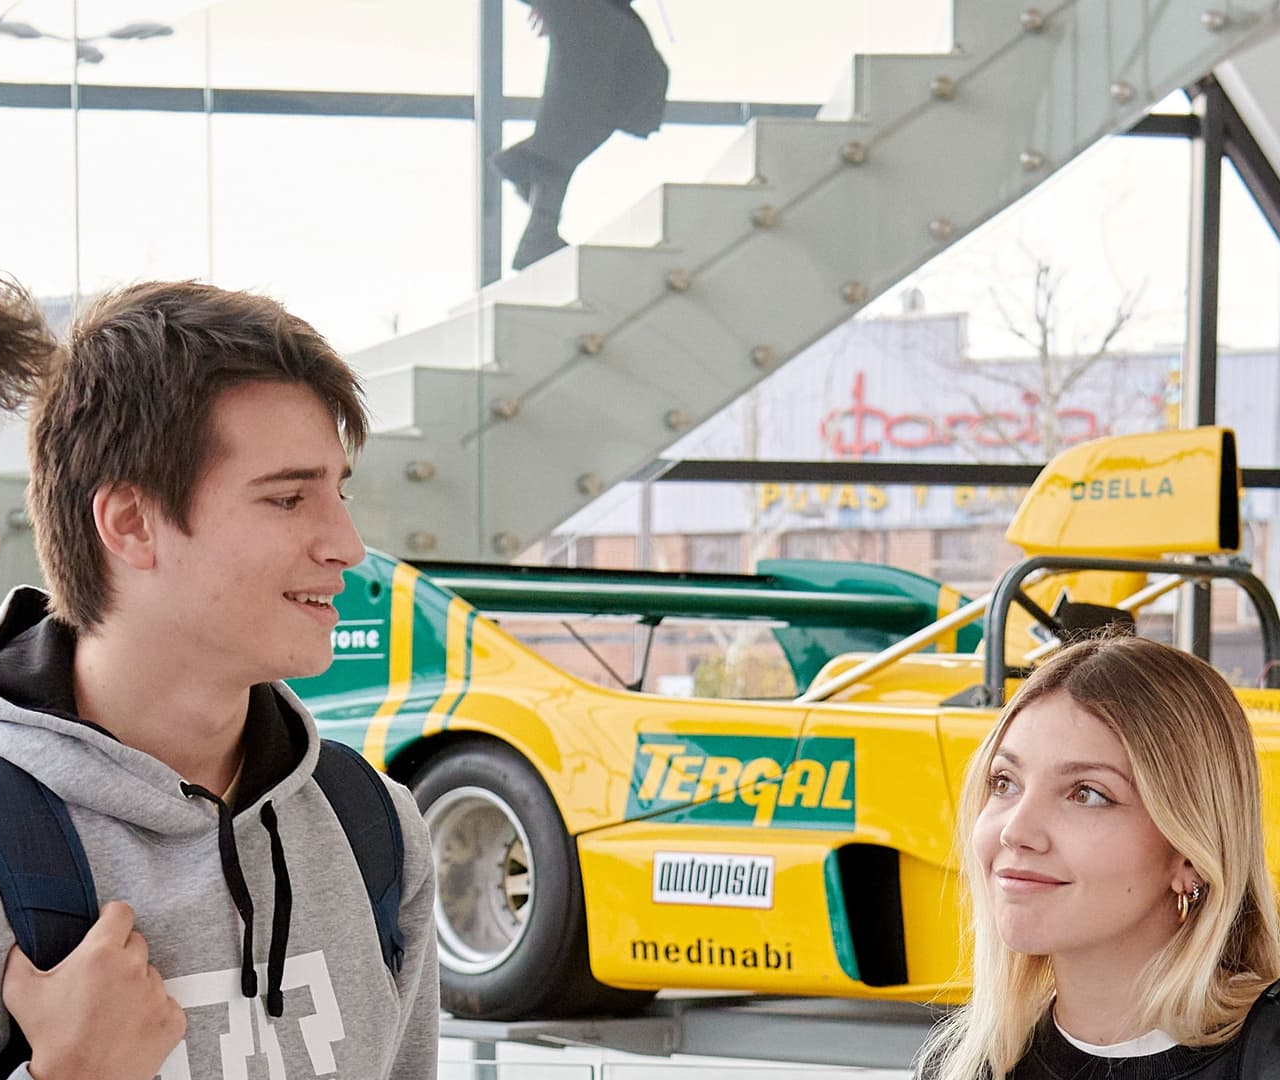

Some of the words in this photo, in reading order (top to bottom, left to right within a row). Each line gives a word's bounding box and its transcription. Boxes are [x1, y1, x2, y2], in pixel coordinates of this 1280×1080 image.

[1070, 477, 1174, 501] OSELLA
[637, 743, 854, 827] TERGAL
[659, 857, 770, 900] autopista
[631, 938, 792, 970] medinabi
